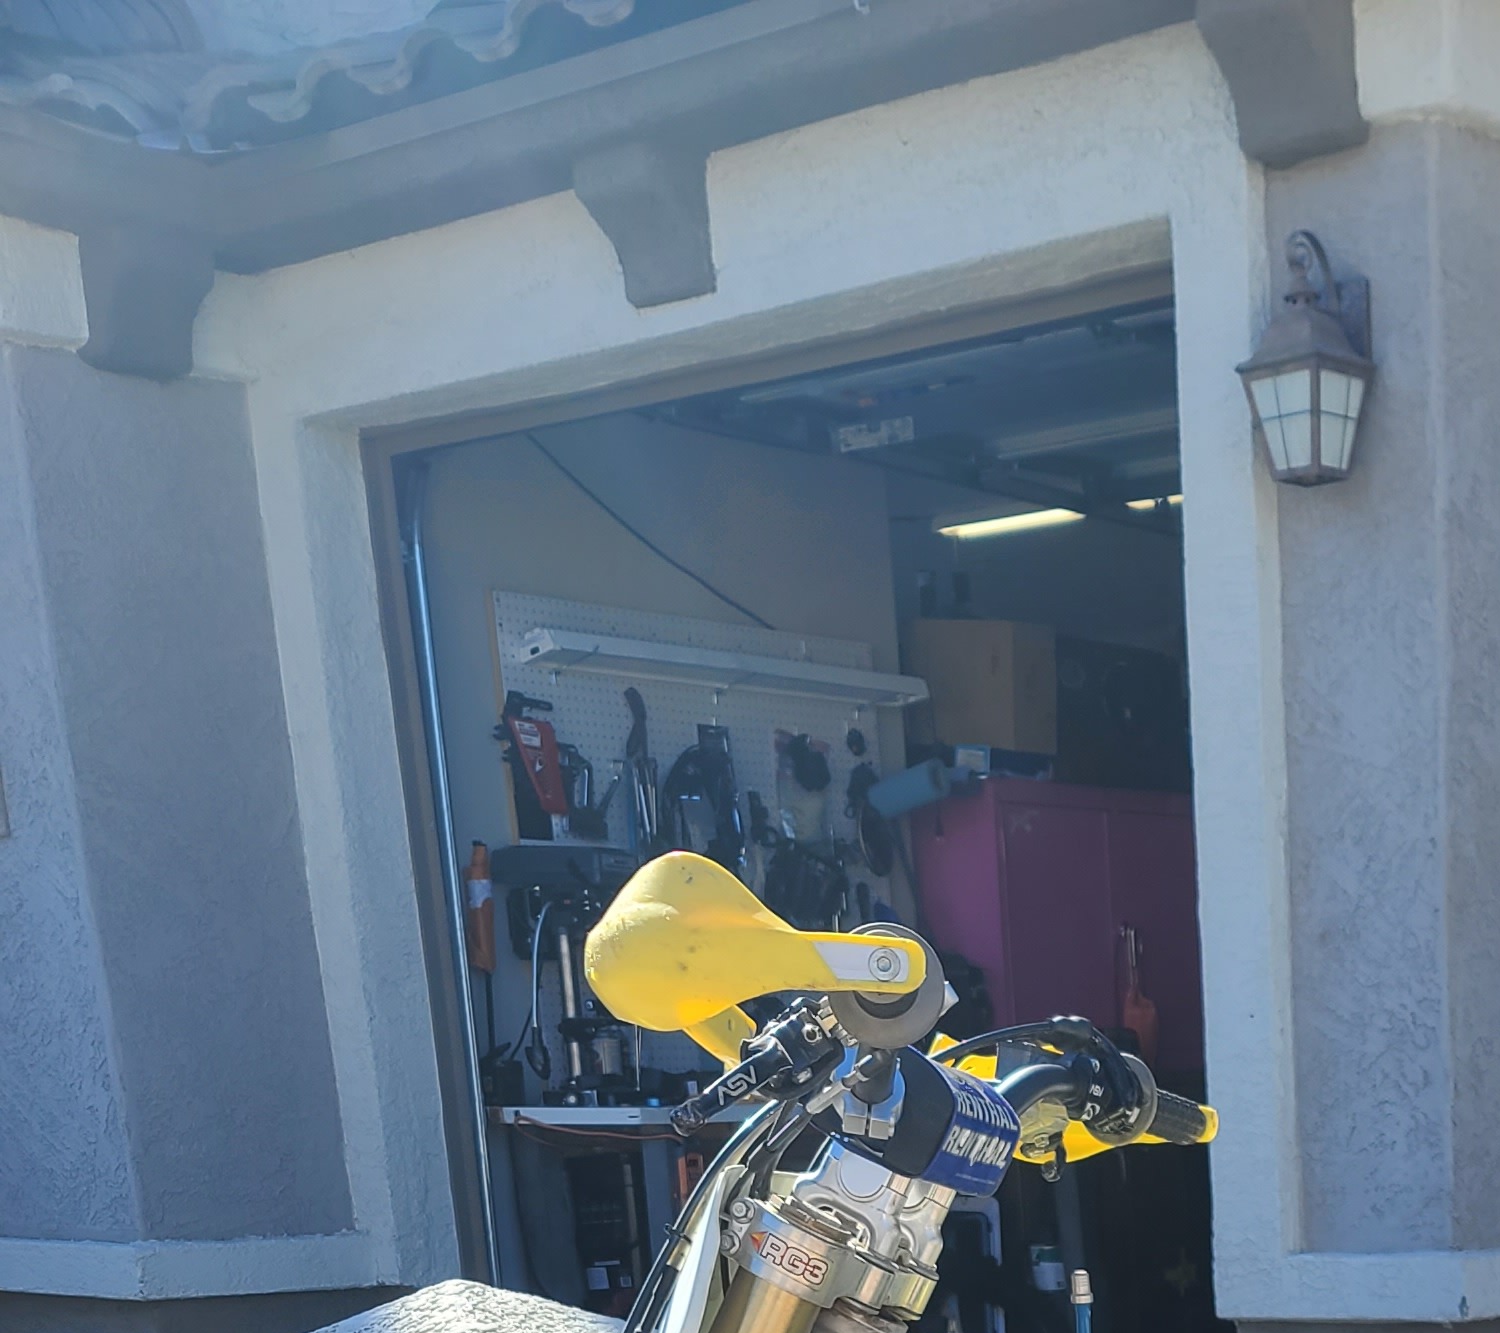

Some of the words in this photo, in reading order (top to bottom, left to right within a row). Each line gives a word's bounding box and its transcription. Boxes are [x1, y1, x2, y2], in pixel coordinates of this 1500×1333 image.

[718, 1065, 757, 1106] ASV
[955, 1091, 1019, 1131] RENTHAL
[760, 1232, 829, 1286] RG3
